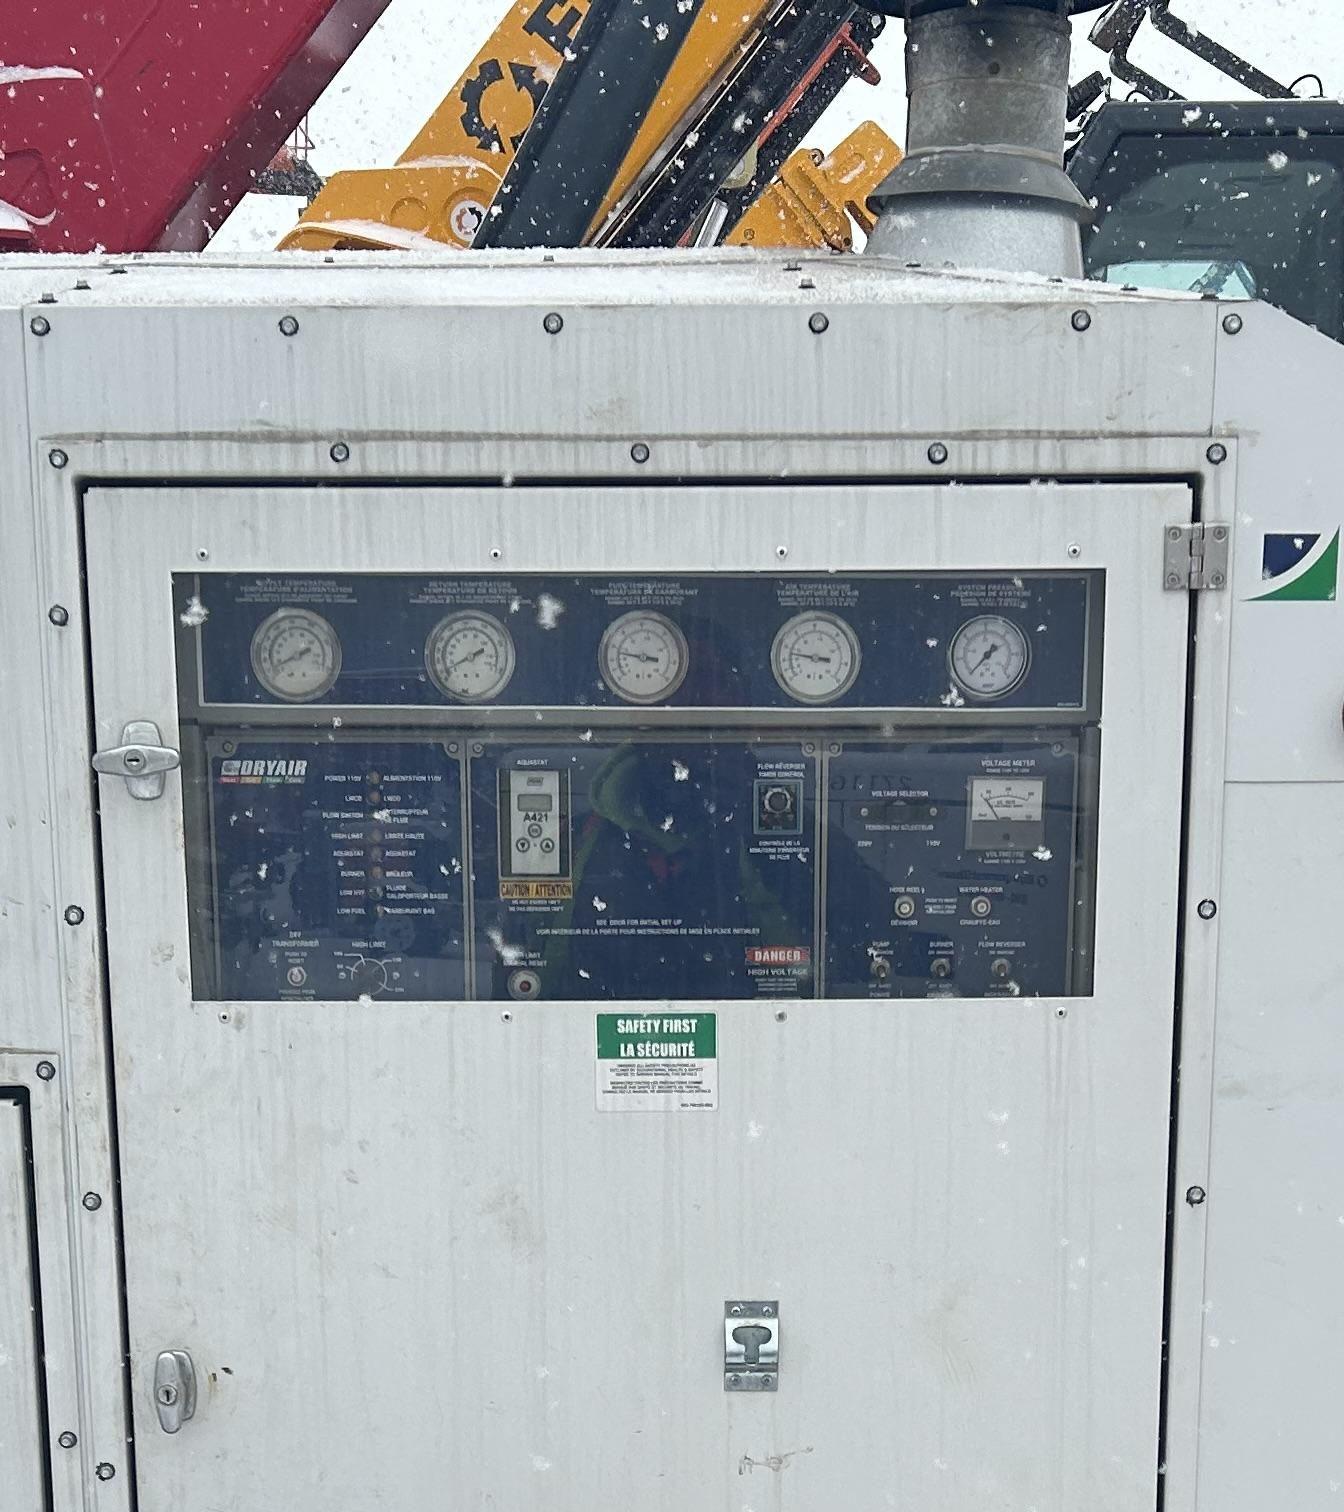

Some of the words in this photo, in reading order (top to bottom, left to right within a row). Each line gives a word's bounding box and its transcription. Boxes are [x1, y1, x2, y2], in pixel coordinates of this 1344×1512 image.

[240, 760, 308, 776] DRYAIR
[981, 759, 1011, 767] VOLTAGE
[523, 812, 549, 823] A421
[501, 884, 530, 896] CAUTION
[535, 884, 571, 896] ATTENTION
[754, 950, 802, 962] DANGER
[617, 1018, 662, 1034] SAFETY
[662, 1018, 698, 1034] FIRST
[619, 1042, 635, 1057] LA
[636, 1040, 696, 1057] SÉCURITÉ
